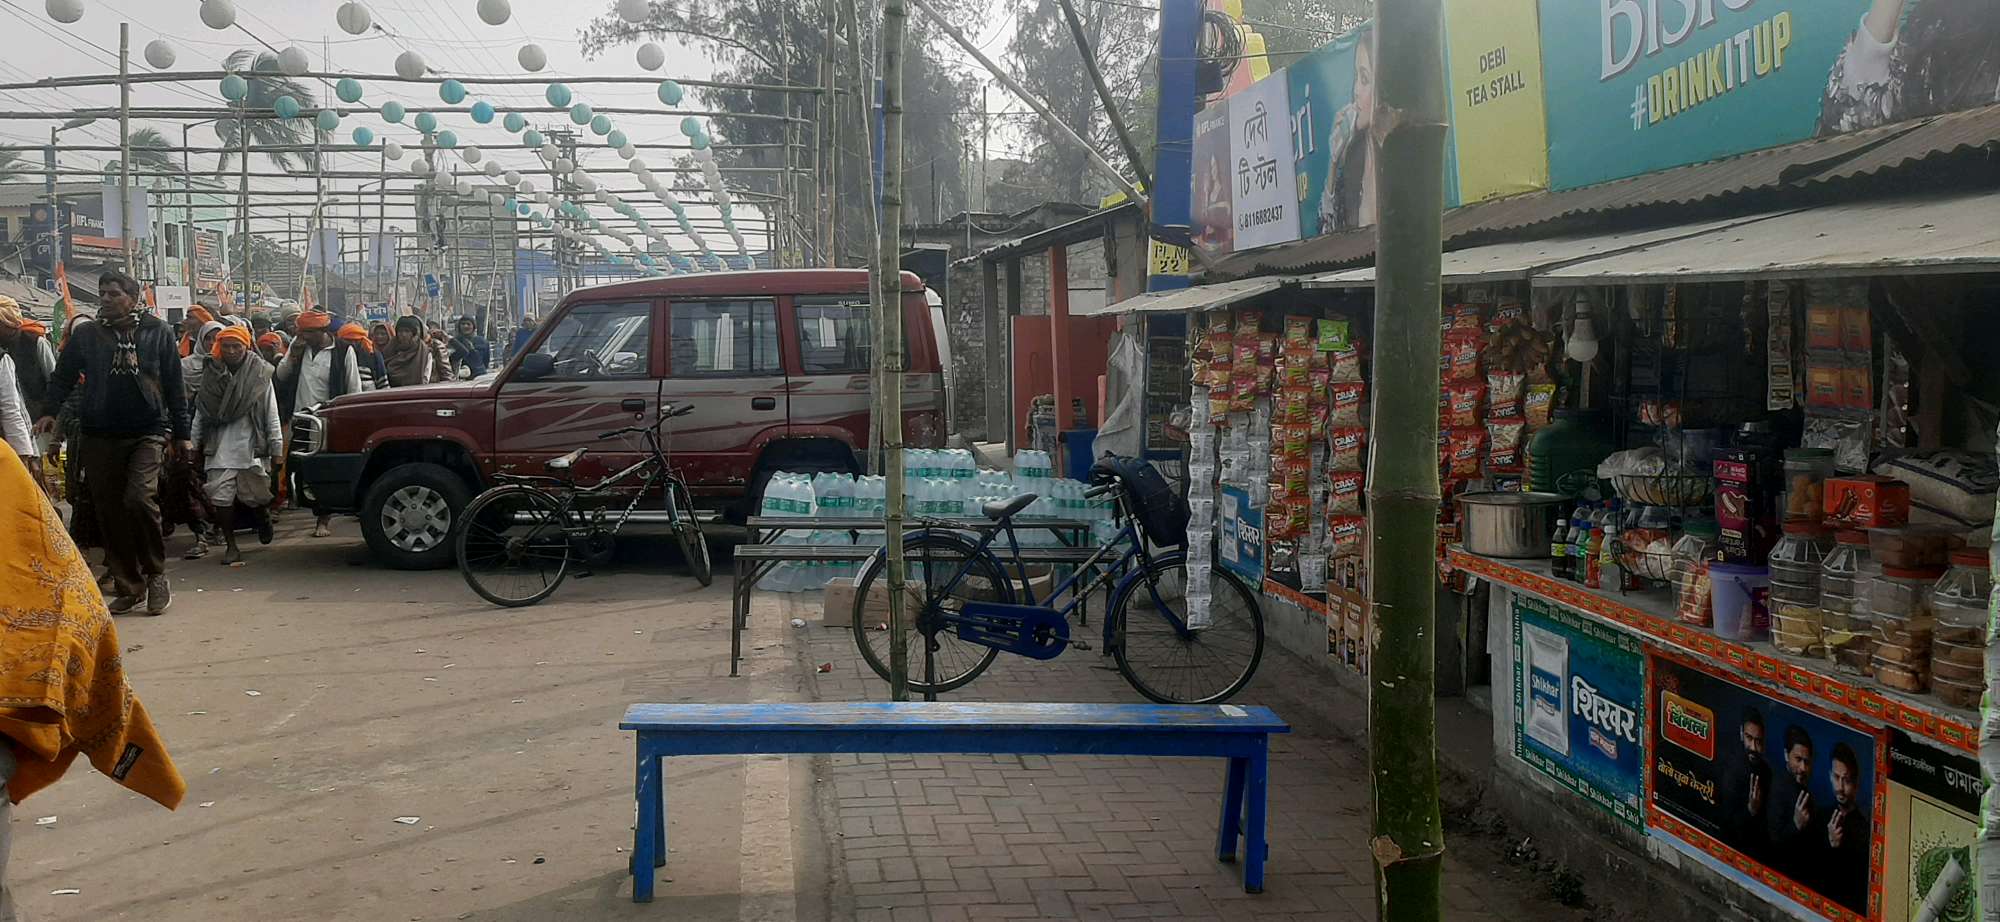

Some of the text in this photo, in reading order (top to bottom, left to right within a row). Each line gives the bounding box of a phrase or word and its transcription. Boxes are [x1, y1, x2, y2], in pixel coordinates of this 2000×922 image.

[1600, 0, 1752, 81] Bis
[1479, 46, 1506, 74] DEBI
[1630, 11, 1793, 130] #DRINKITUP
[1466, 70, 1525, 107] TEA STALL
[1244, 100, 1268, 149] দেবী
[1291, 83, 1315, 161] ri
[1238, 156, 1279, 199] টি স্টল
[1160, 260, 1179, 273] 22
[1335, 389, 1358, 401] CRAX
[1334, 434, 1358, 446] CRAX
[1334, 477, 1356, 489] CRAX
[1560, 611, 1581, 630] Shikhar
[1593, 627, 1617, 645] Shikhar
[1531, 674, 1560, 698] Shikhar
[1571, 675, 1637, 743] शिखर
[1525, 748, 1546, 767] Shikhar
[1556, 767, 1578, 787] Shikhar
[1589, 787, 1613, 808] Shikhar
